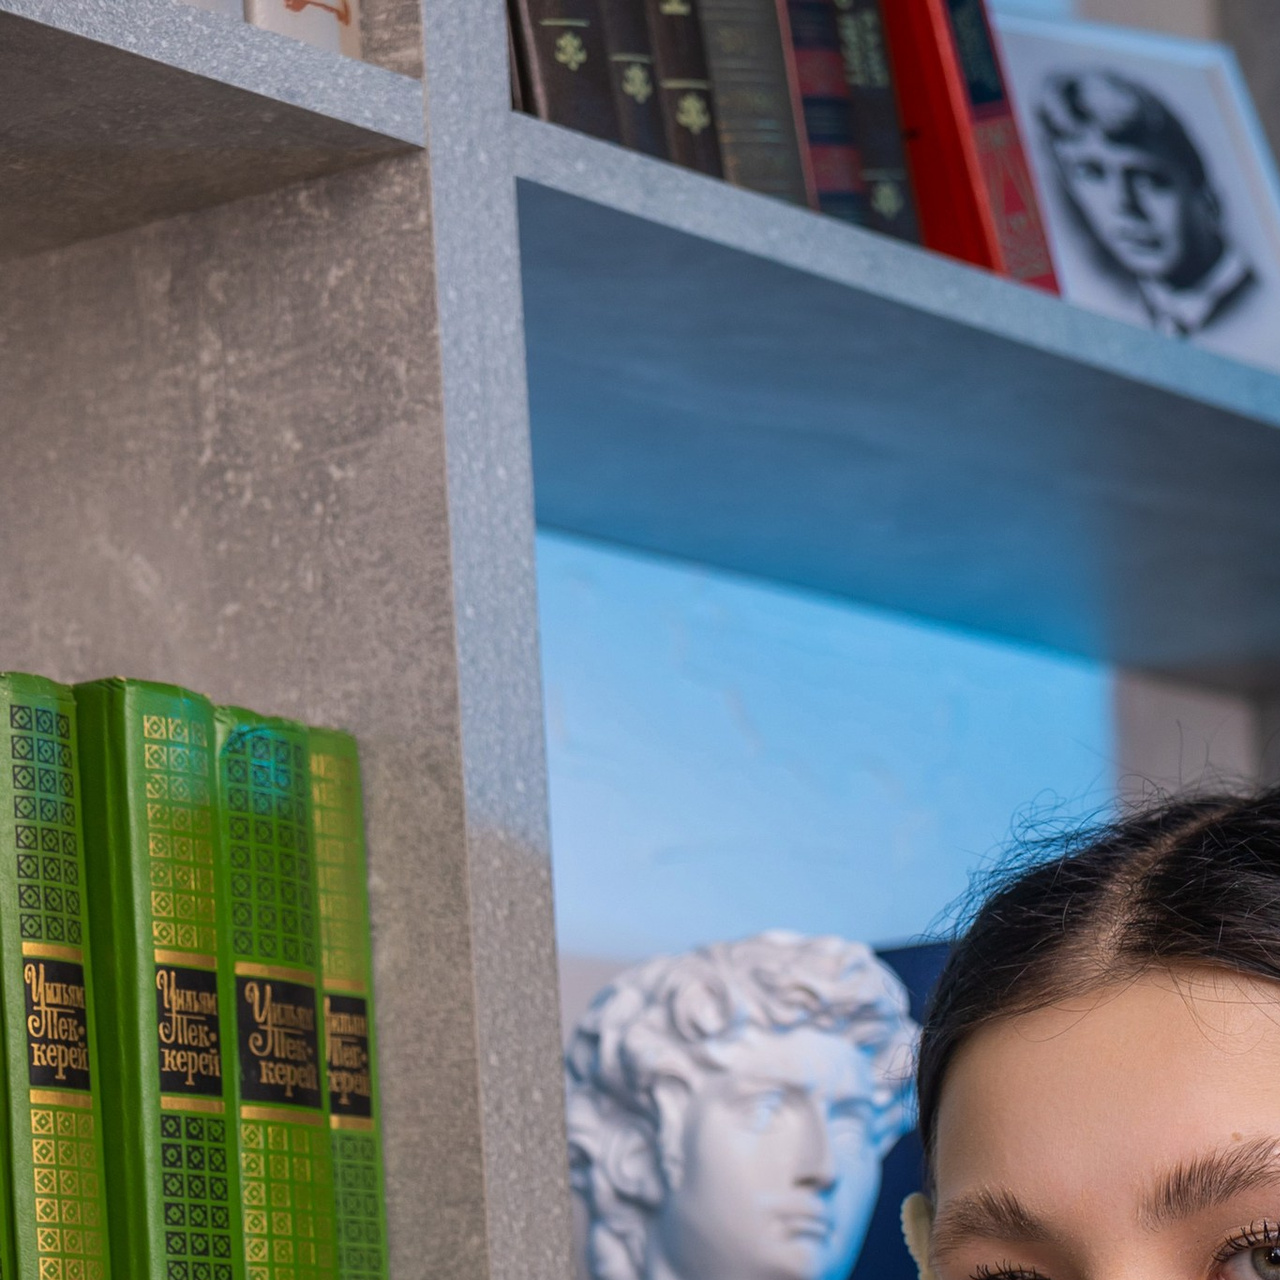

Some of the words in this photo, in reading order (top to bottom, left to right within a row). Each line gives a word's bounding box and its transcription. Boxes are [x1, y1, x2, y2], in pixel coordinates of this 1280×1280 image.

[24, 963, 85, 1008] Уильям
[156, 970, 217, 1015] Уильям
[31, 1043, 89, 1080] керей
[160, 1048, 220, 1085] керей
